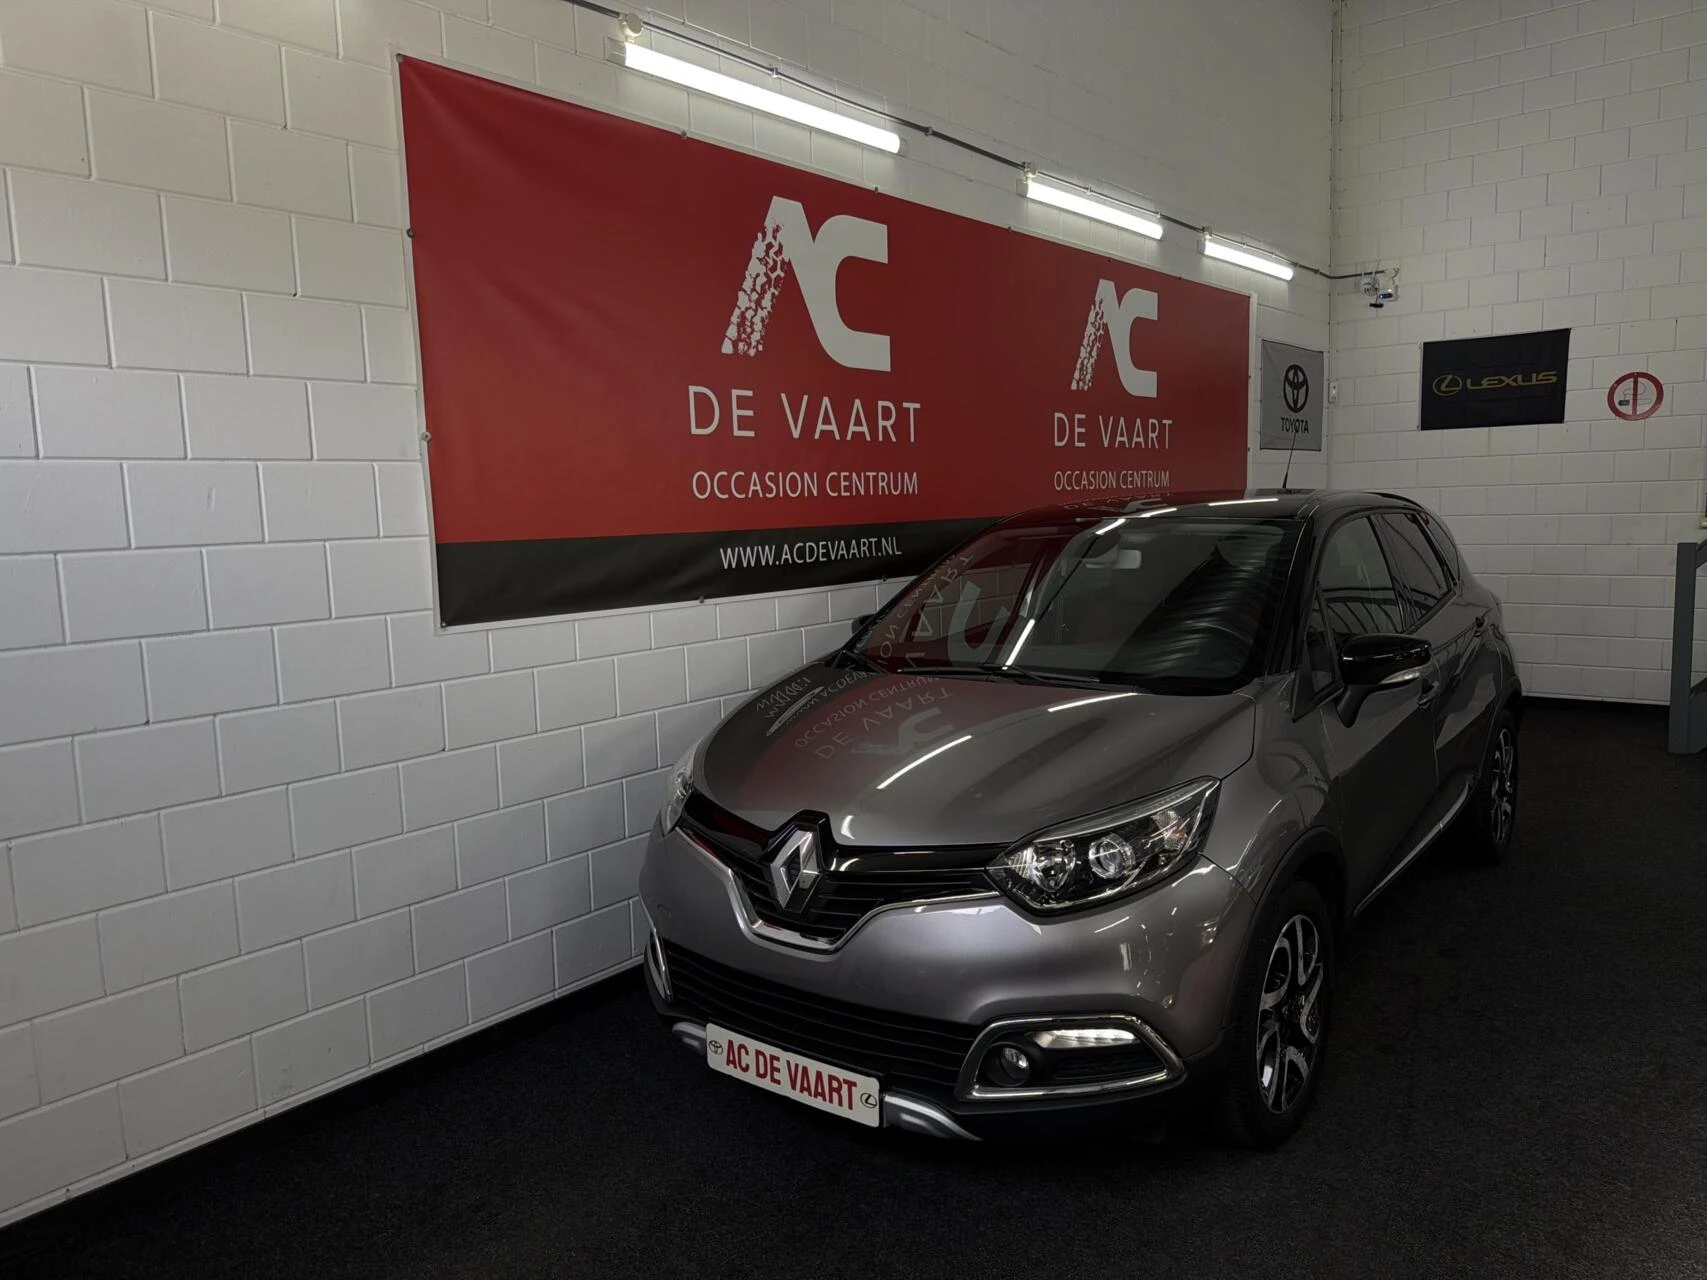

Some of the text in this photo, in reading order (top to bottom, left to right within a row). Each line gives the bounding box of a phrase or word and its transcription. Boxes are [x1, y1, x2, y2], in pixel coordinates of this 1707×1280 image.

[721, 196, 891, 371] AC
[1070, 278, 1158, 398] AC
[1466, 371, 1558, 390] LEXUS
[688, 385, 921, 443] DE VAART
[1054, 412, 1173, 449] DE VAART
[1281, 416, 1309, 434] TOYOTA
[692, 470, 919, 499] OCCASION CENTRUM
[1054, 470, 1170, 491] OCCASION CENTRUM
[720, 536, 902, 569] WWW.ACDEVAART.NL
[726, 1039, 857, 1110] AC DE VAART
